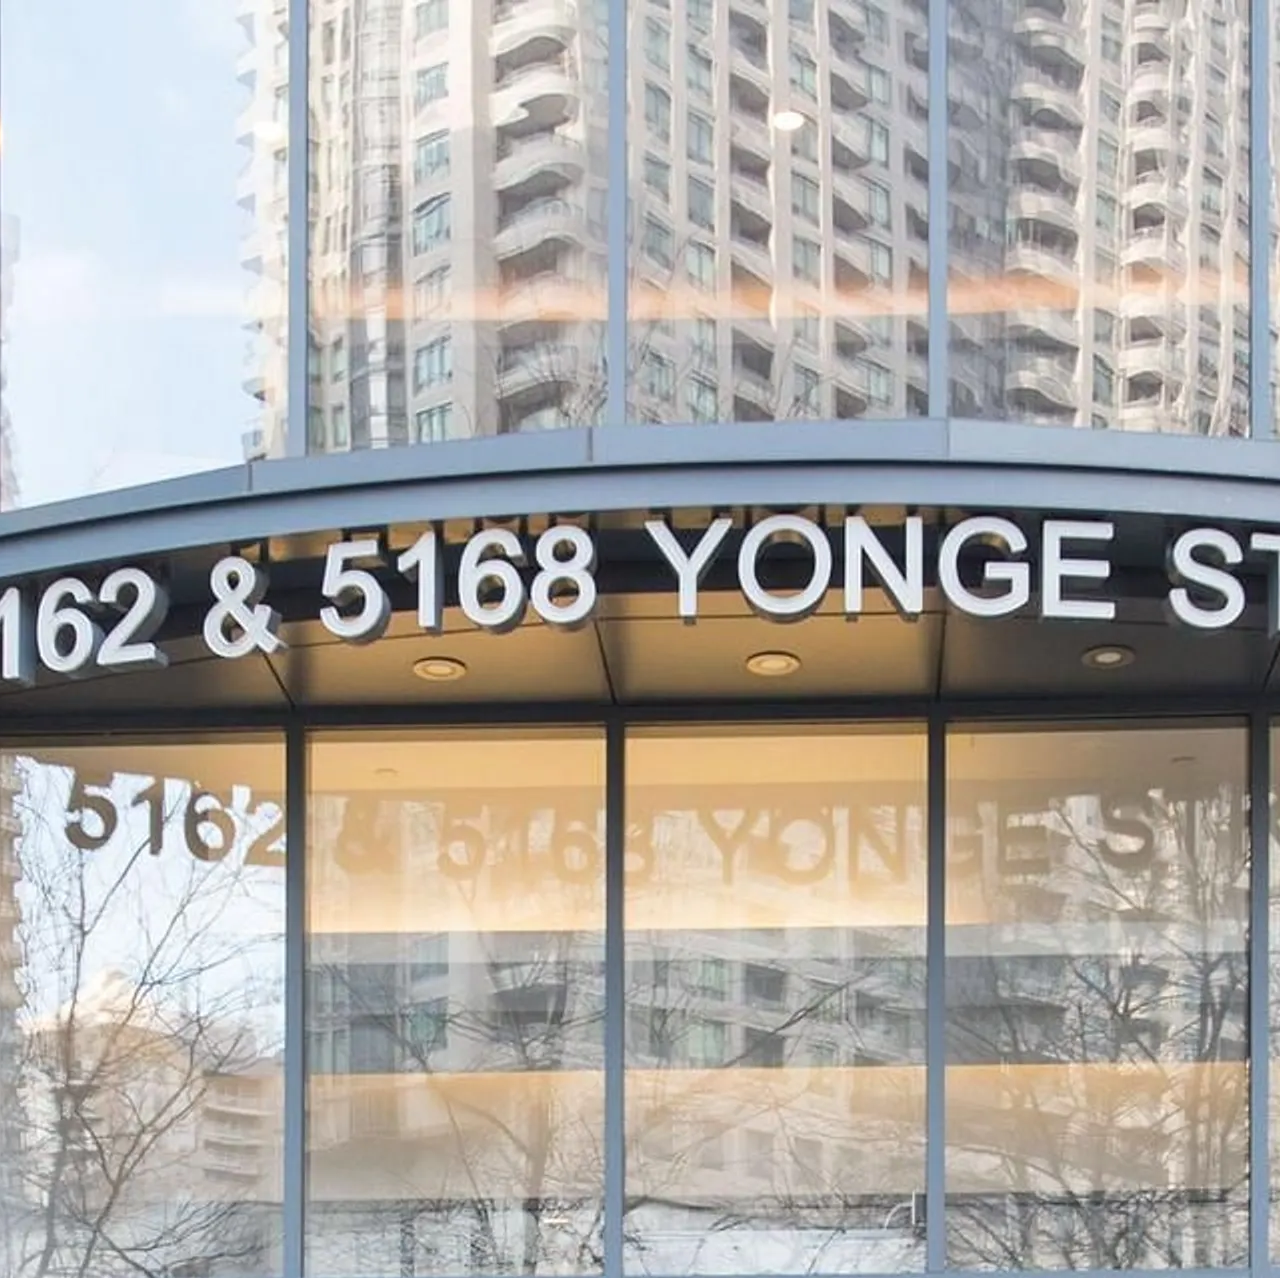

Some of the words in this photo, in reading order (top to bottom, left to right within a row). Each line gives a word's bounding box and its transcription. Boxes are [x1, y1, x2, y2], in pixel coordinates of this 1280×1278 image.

[202, 555, 288, 660] &
[320, 525, 597, 640] 5168
[644, 513, 1117, 622] YONGE
